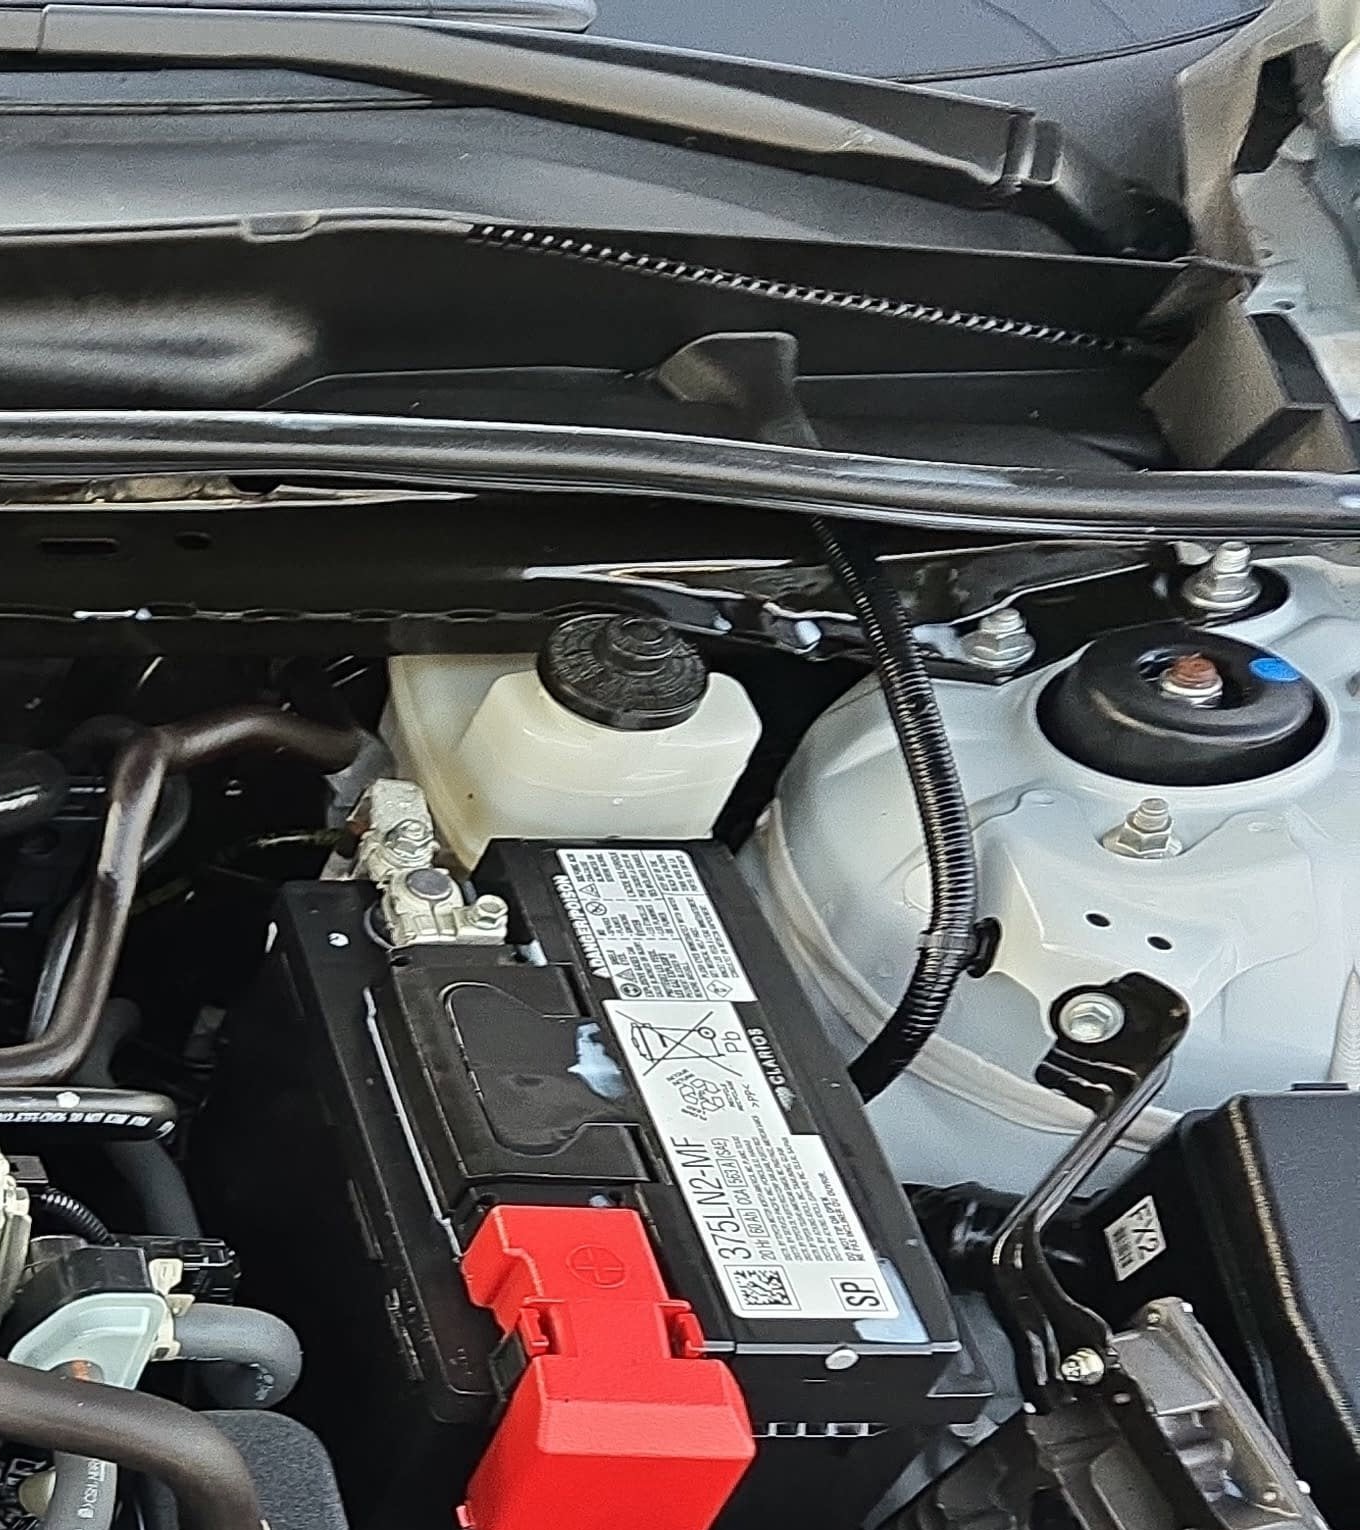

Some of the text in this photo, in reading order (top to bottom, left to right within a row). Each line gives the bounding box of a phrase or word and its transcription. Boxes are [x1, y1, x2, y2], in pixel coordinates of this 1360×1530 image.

[551, 874, 606, 967] DANGER/POISON
[723, 1031, 742, 1052] Pb
[746, 1027, 788, 1084] CLARIOS
[709, 1137, 736, 1158] (SAE)
[723, 1169, 743, 1183] 563
[669, 1136, 752, 1259] 375LN2-MF
[731, 1188, 752, 1204] CCA
[740, 1211, 759, 1222] Ah
[746, 1223, 764, 1233] 60
[757, 1250, 776, 1260] 20
[837, 1281, 881, 1306] SP
